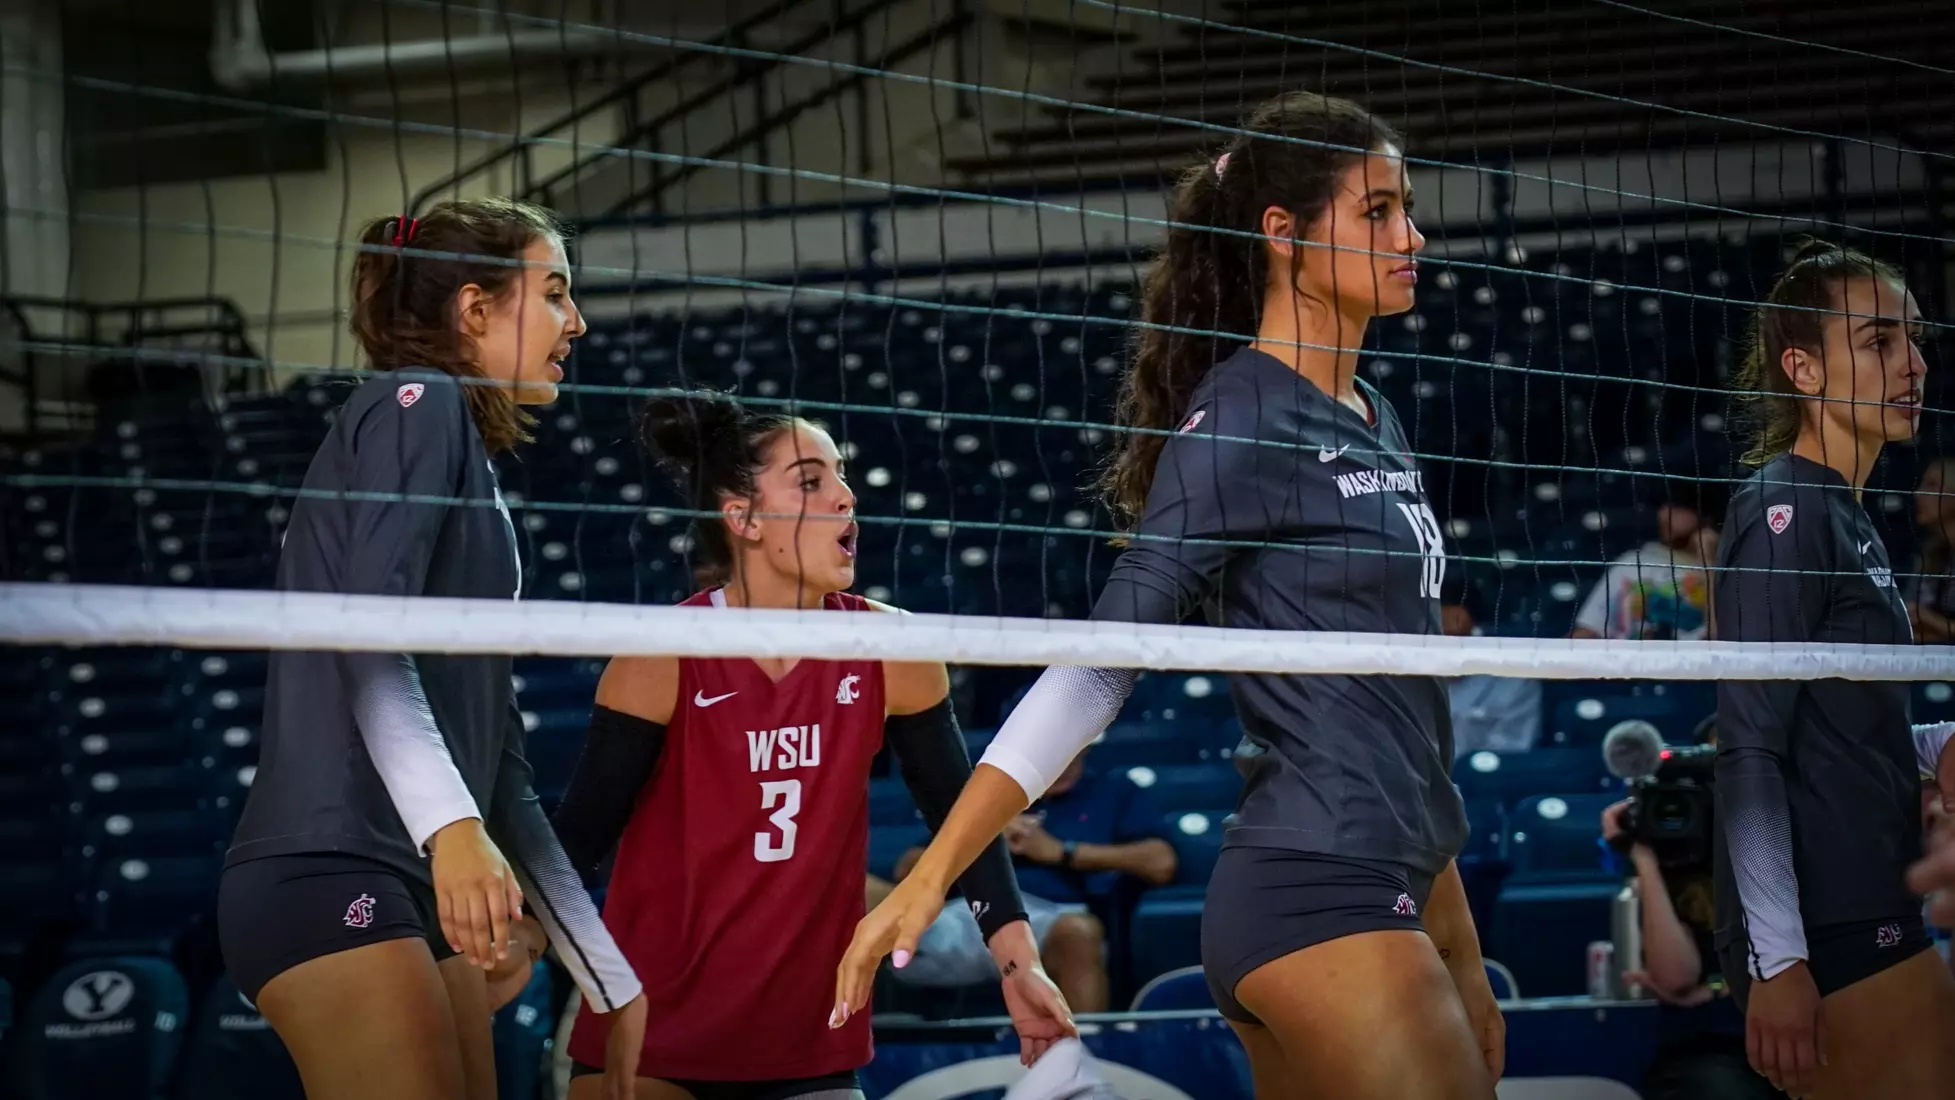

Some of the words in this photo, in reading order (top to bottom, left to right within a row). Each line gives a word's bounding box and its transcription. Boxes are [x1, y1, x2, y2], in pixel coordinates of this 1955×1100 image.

[1395, 502, 1446, 599] 18
[745, 723, 820, 773] WSU
[753, 779, 802, 863] 3
